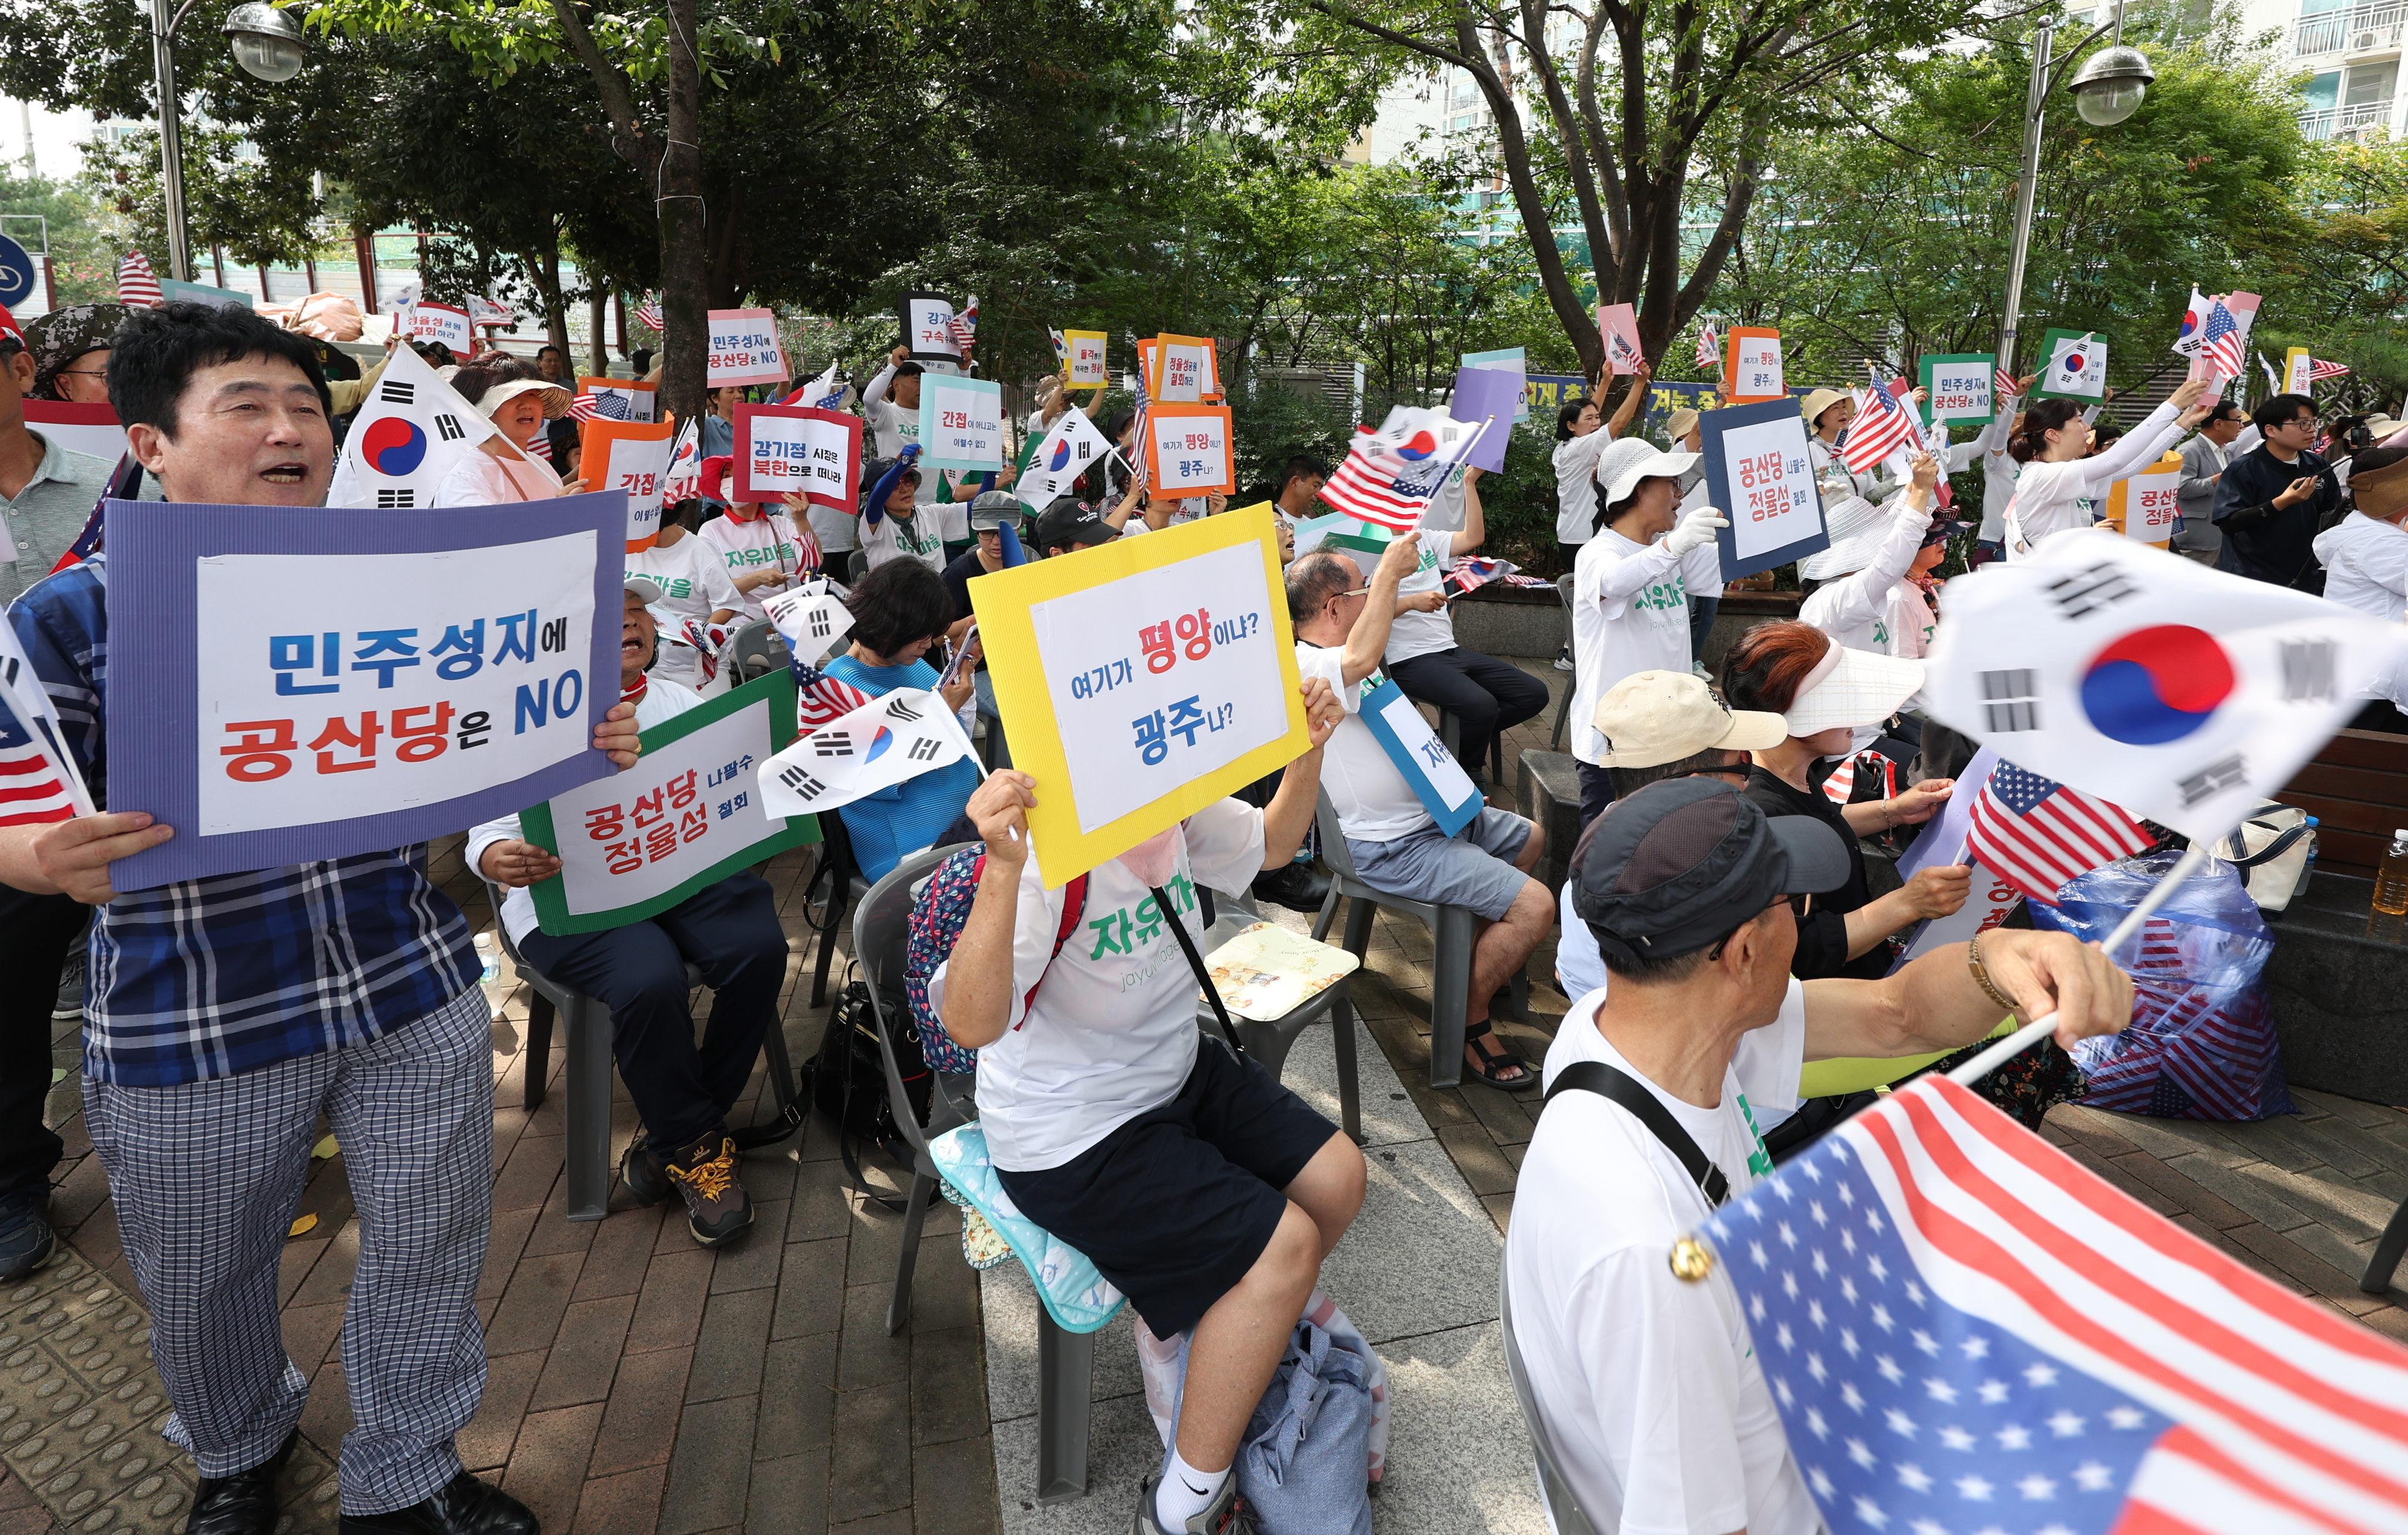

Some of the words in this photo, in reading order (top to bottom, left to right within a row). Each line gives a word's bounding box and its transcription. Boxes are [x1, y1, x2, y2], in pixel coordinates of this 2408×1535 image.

[713, 333, 771, 350] 민주성지에
[708, 352, 757, 368] 공산당은
[760, 350, 778, 364] NO
[1170, 357, 1197, 372] 정율성공원
[1171, 373, 1194, 386] 철회하라
[1941, 377, 1986, 392] 민주성지에
[1516, 391, 1525, 405] O
[1934, 394, 1975, 409] 공산당은
[1976, 394, 1990, 406] NO
[635, 411, 651, 421] 시장은
[942, 411, 974, 429] 간첩이
[975, 421, 997, 432] 아니고는
[754, 440, 807, 459] 강기정
[813, 448, 839, 464] 시장은
[975, 439, 986, 449] 없다
[1162, 441, 1182, 450] 여기가
[754, 460, 811, 477] 북한으로
[818, 467, 842, 484] 떠나라
[1739, 450, 1783, 488] 공산당
[1786, 457, 1806, 474] 나팔수
[1748, 483, 1790, 523] 정율성
[1793, 489, 1807, 506] 철회
[724, 542, 795, 569] 자유마을
[269, 608, 568, 696] 민주성지에
[1070, 657, 1134, 700] 여기가
[1138, 607, 1259, 675] 평양이냐?
[219, 700, 492, 783] 공산당은
[514, 668, 583, 736] NO
[1131, 694, 1233, 766] 광주냐?
[584, 768, 698, 841] 공산당
[707, 754, 754, 789] 나팔수
[603, 802, 709, 876] 정율성
[717, 790, 749, 820] 철회
[1121, 919, 1204, 993] jayuvillagecom
